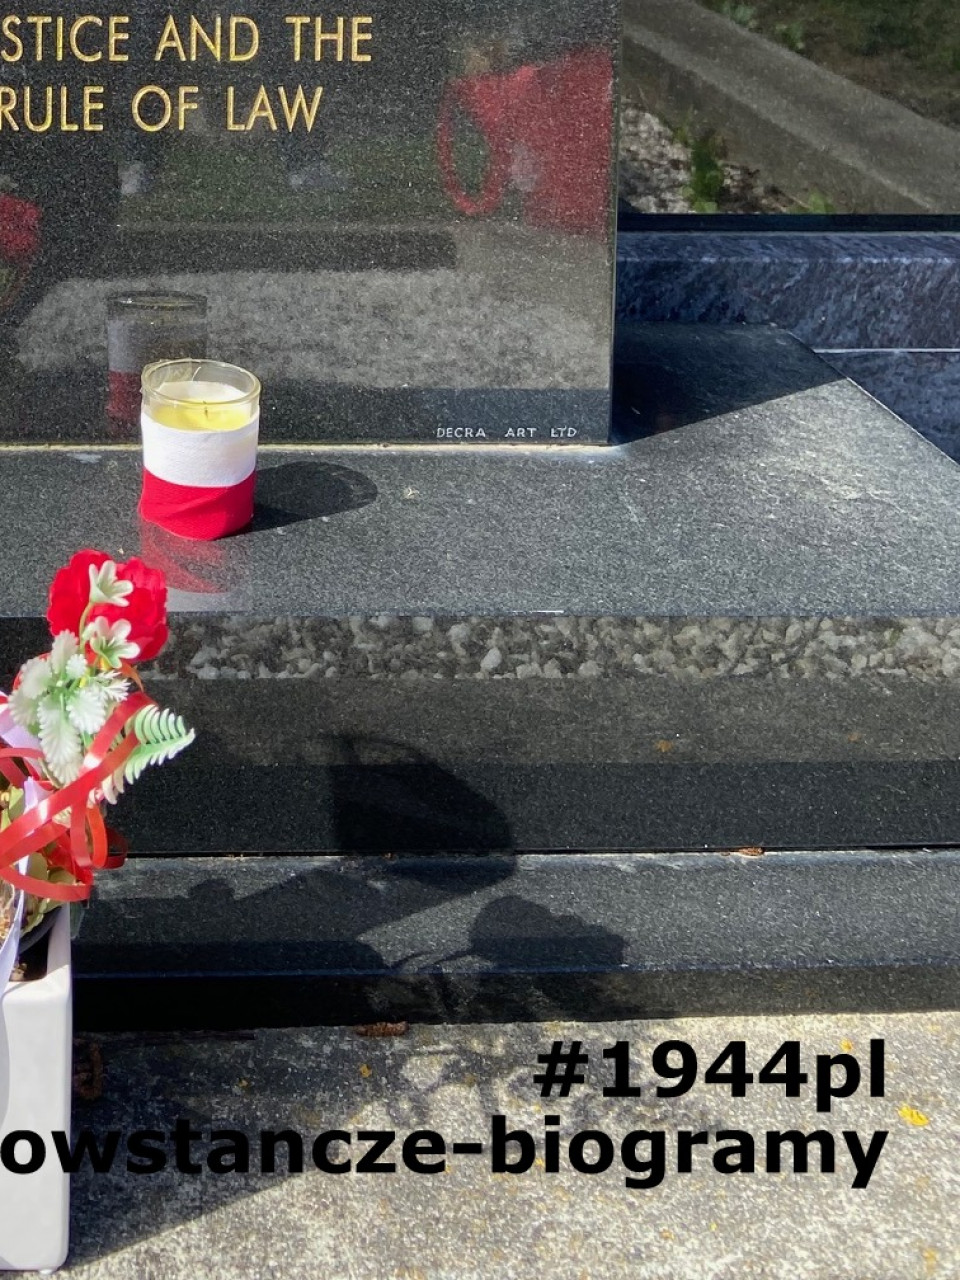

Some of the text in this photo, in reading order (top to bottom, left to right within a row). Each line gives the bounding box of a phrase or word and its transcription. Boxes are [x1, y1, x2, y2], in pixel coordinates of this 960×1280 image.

[156, 16, 259, 61] AND
[286, 16, 372, 62] THE
[132, 85, 198, 132] OF
[227, 86, 322, 131] LAW
[436, 426, 577, 438] DECRA ART LTD
